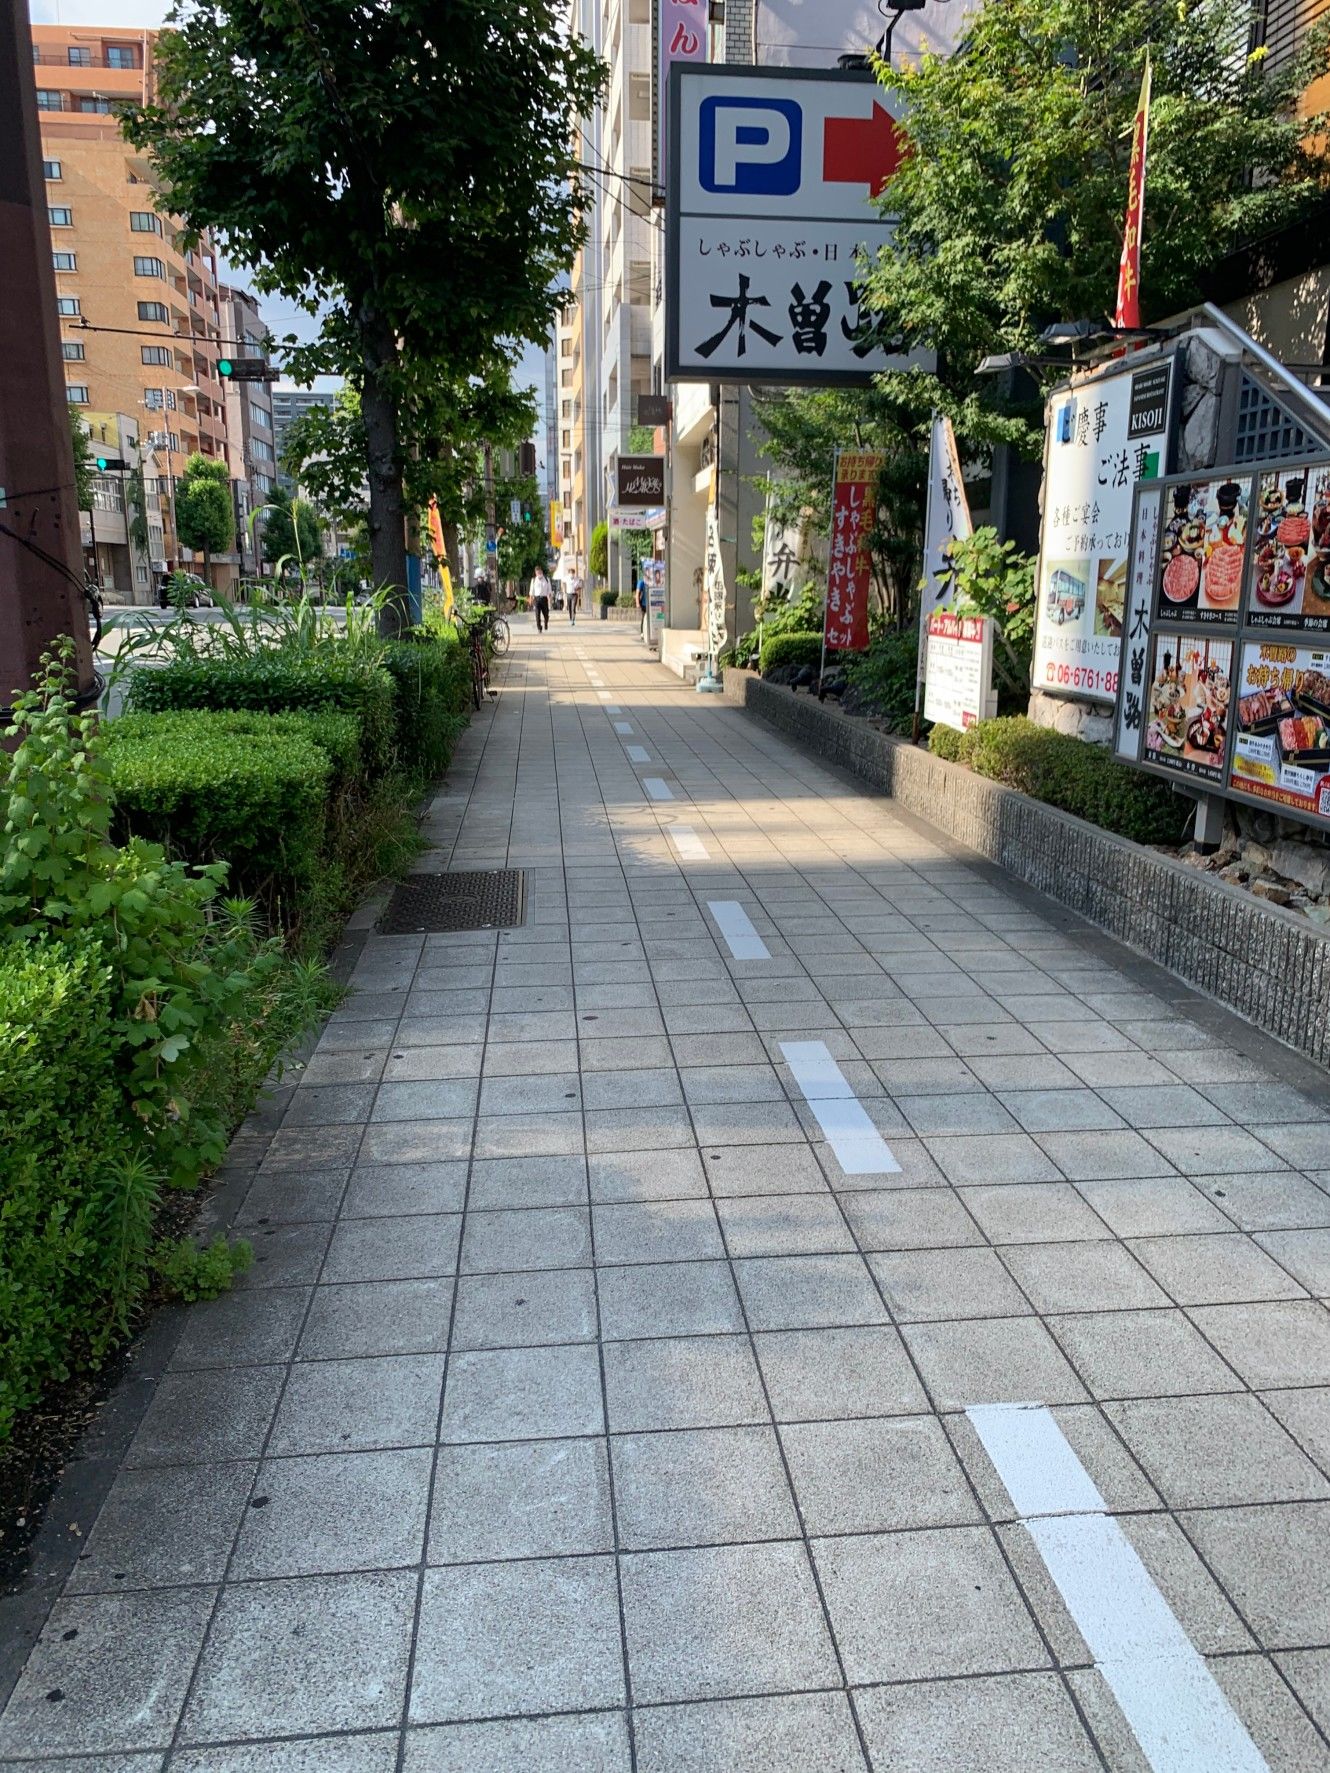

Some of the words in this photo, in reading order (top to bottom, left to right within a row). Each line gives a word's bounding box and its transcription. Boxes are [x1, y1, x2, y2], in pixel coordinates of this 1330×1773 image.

[713, 105, 791, 187] P
[1131, 407, 1164, 432] KISOJI
[1097, 442, 1151, 489] ご法事
[831, 506, 849, 612] すきやき
[840, 485, 861, 624] しゃぶしゃぶ
[827, 628, 852, 646] セット
[1124, 598, 1149, 730] 木曽路
